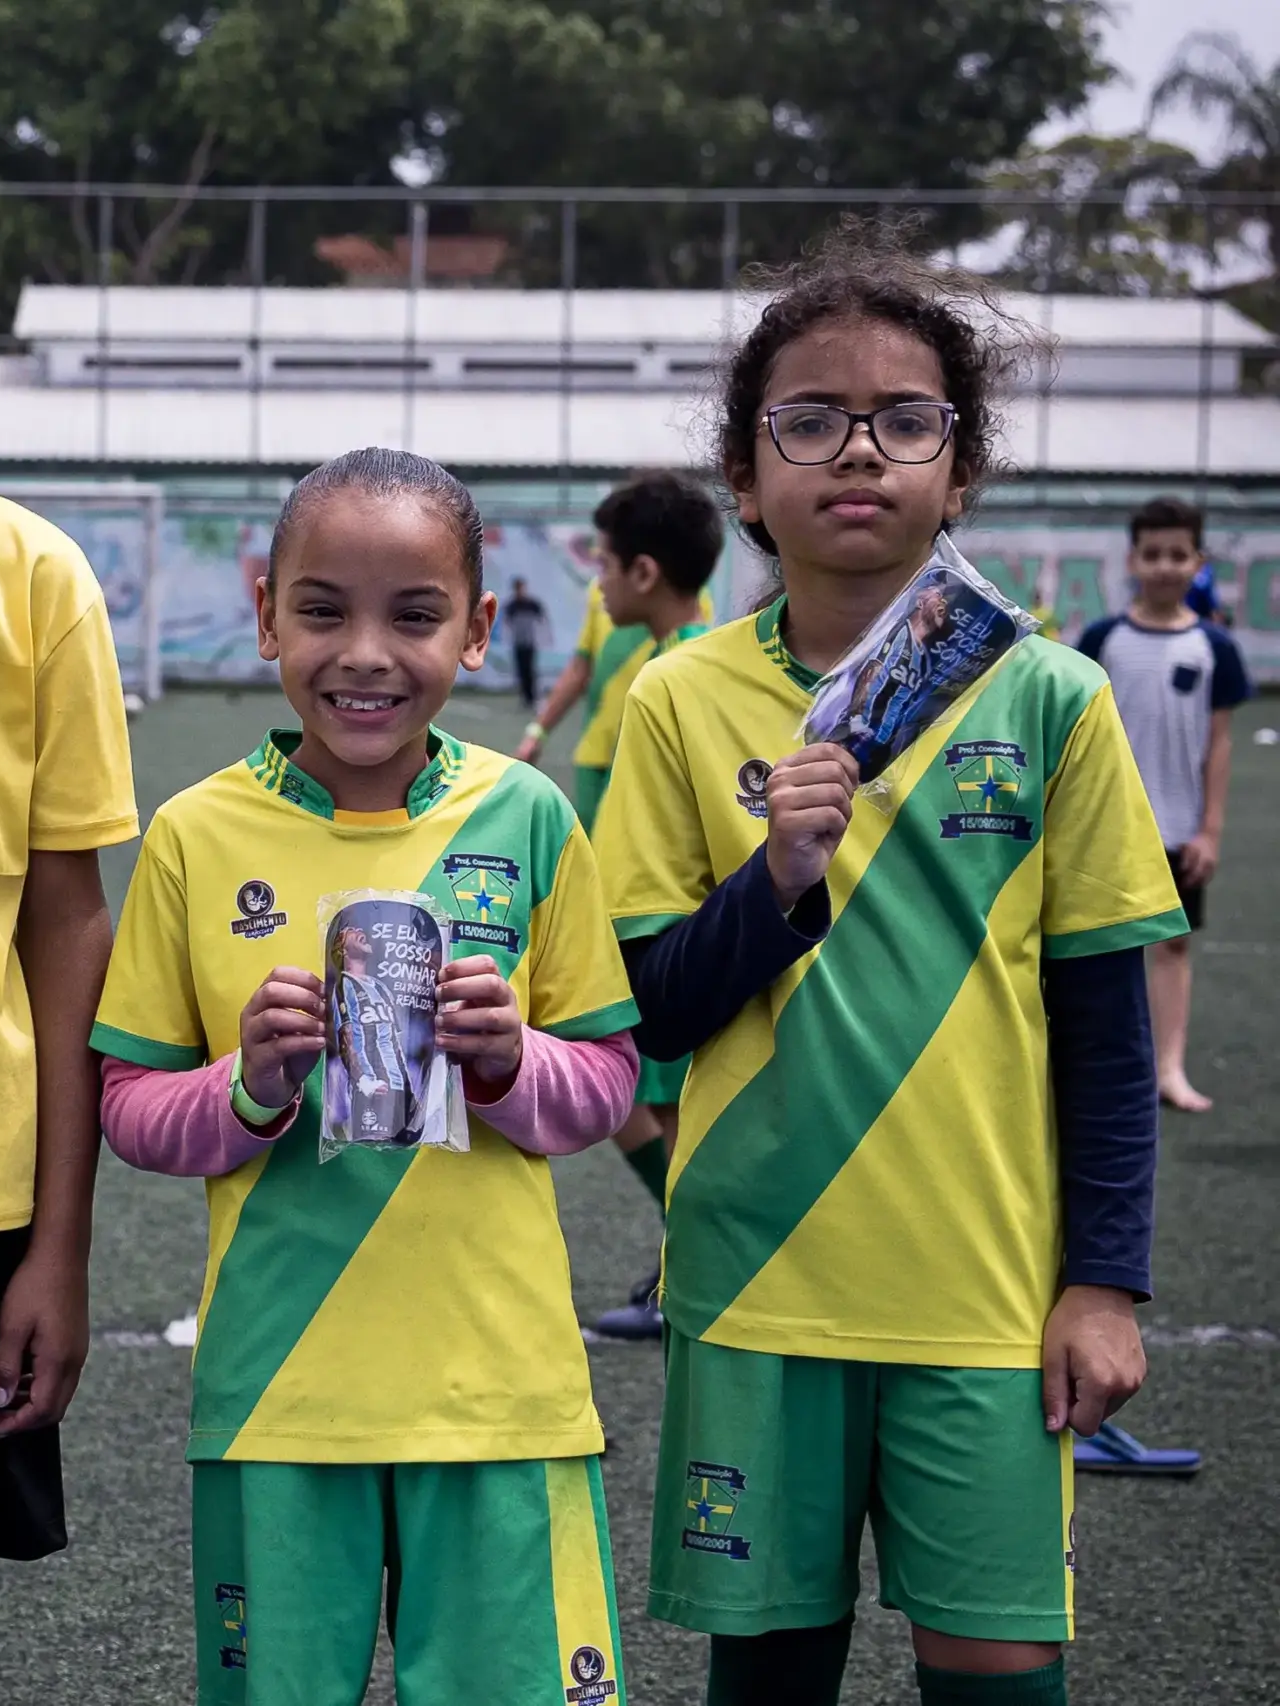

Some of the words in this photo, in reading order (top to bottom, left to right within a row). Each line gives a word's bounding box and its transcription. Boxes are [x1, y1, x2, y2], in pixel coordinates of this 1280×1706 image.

[949, 608, 974, 628] SE
[968, 622, 993, 640] EU
[947, 629, 995, 658] POSSO
[371, 922, 394, 939] SE
[395, 924, 418, 942] EU
[384, 941, 432, 963] POSSO
[377, 961, 437, 989] SONHAR
[393, 981, 406, 992] EU
[406, 983, 431, 997] POSSO
